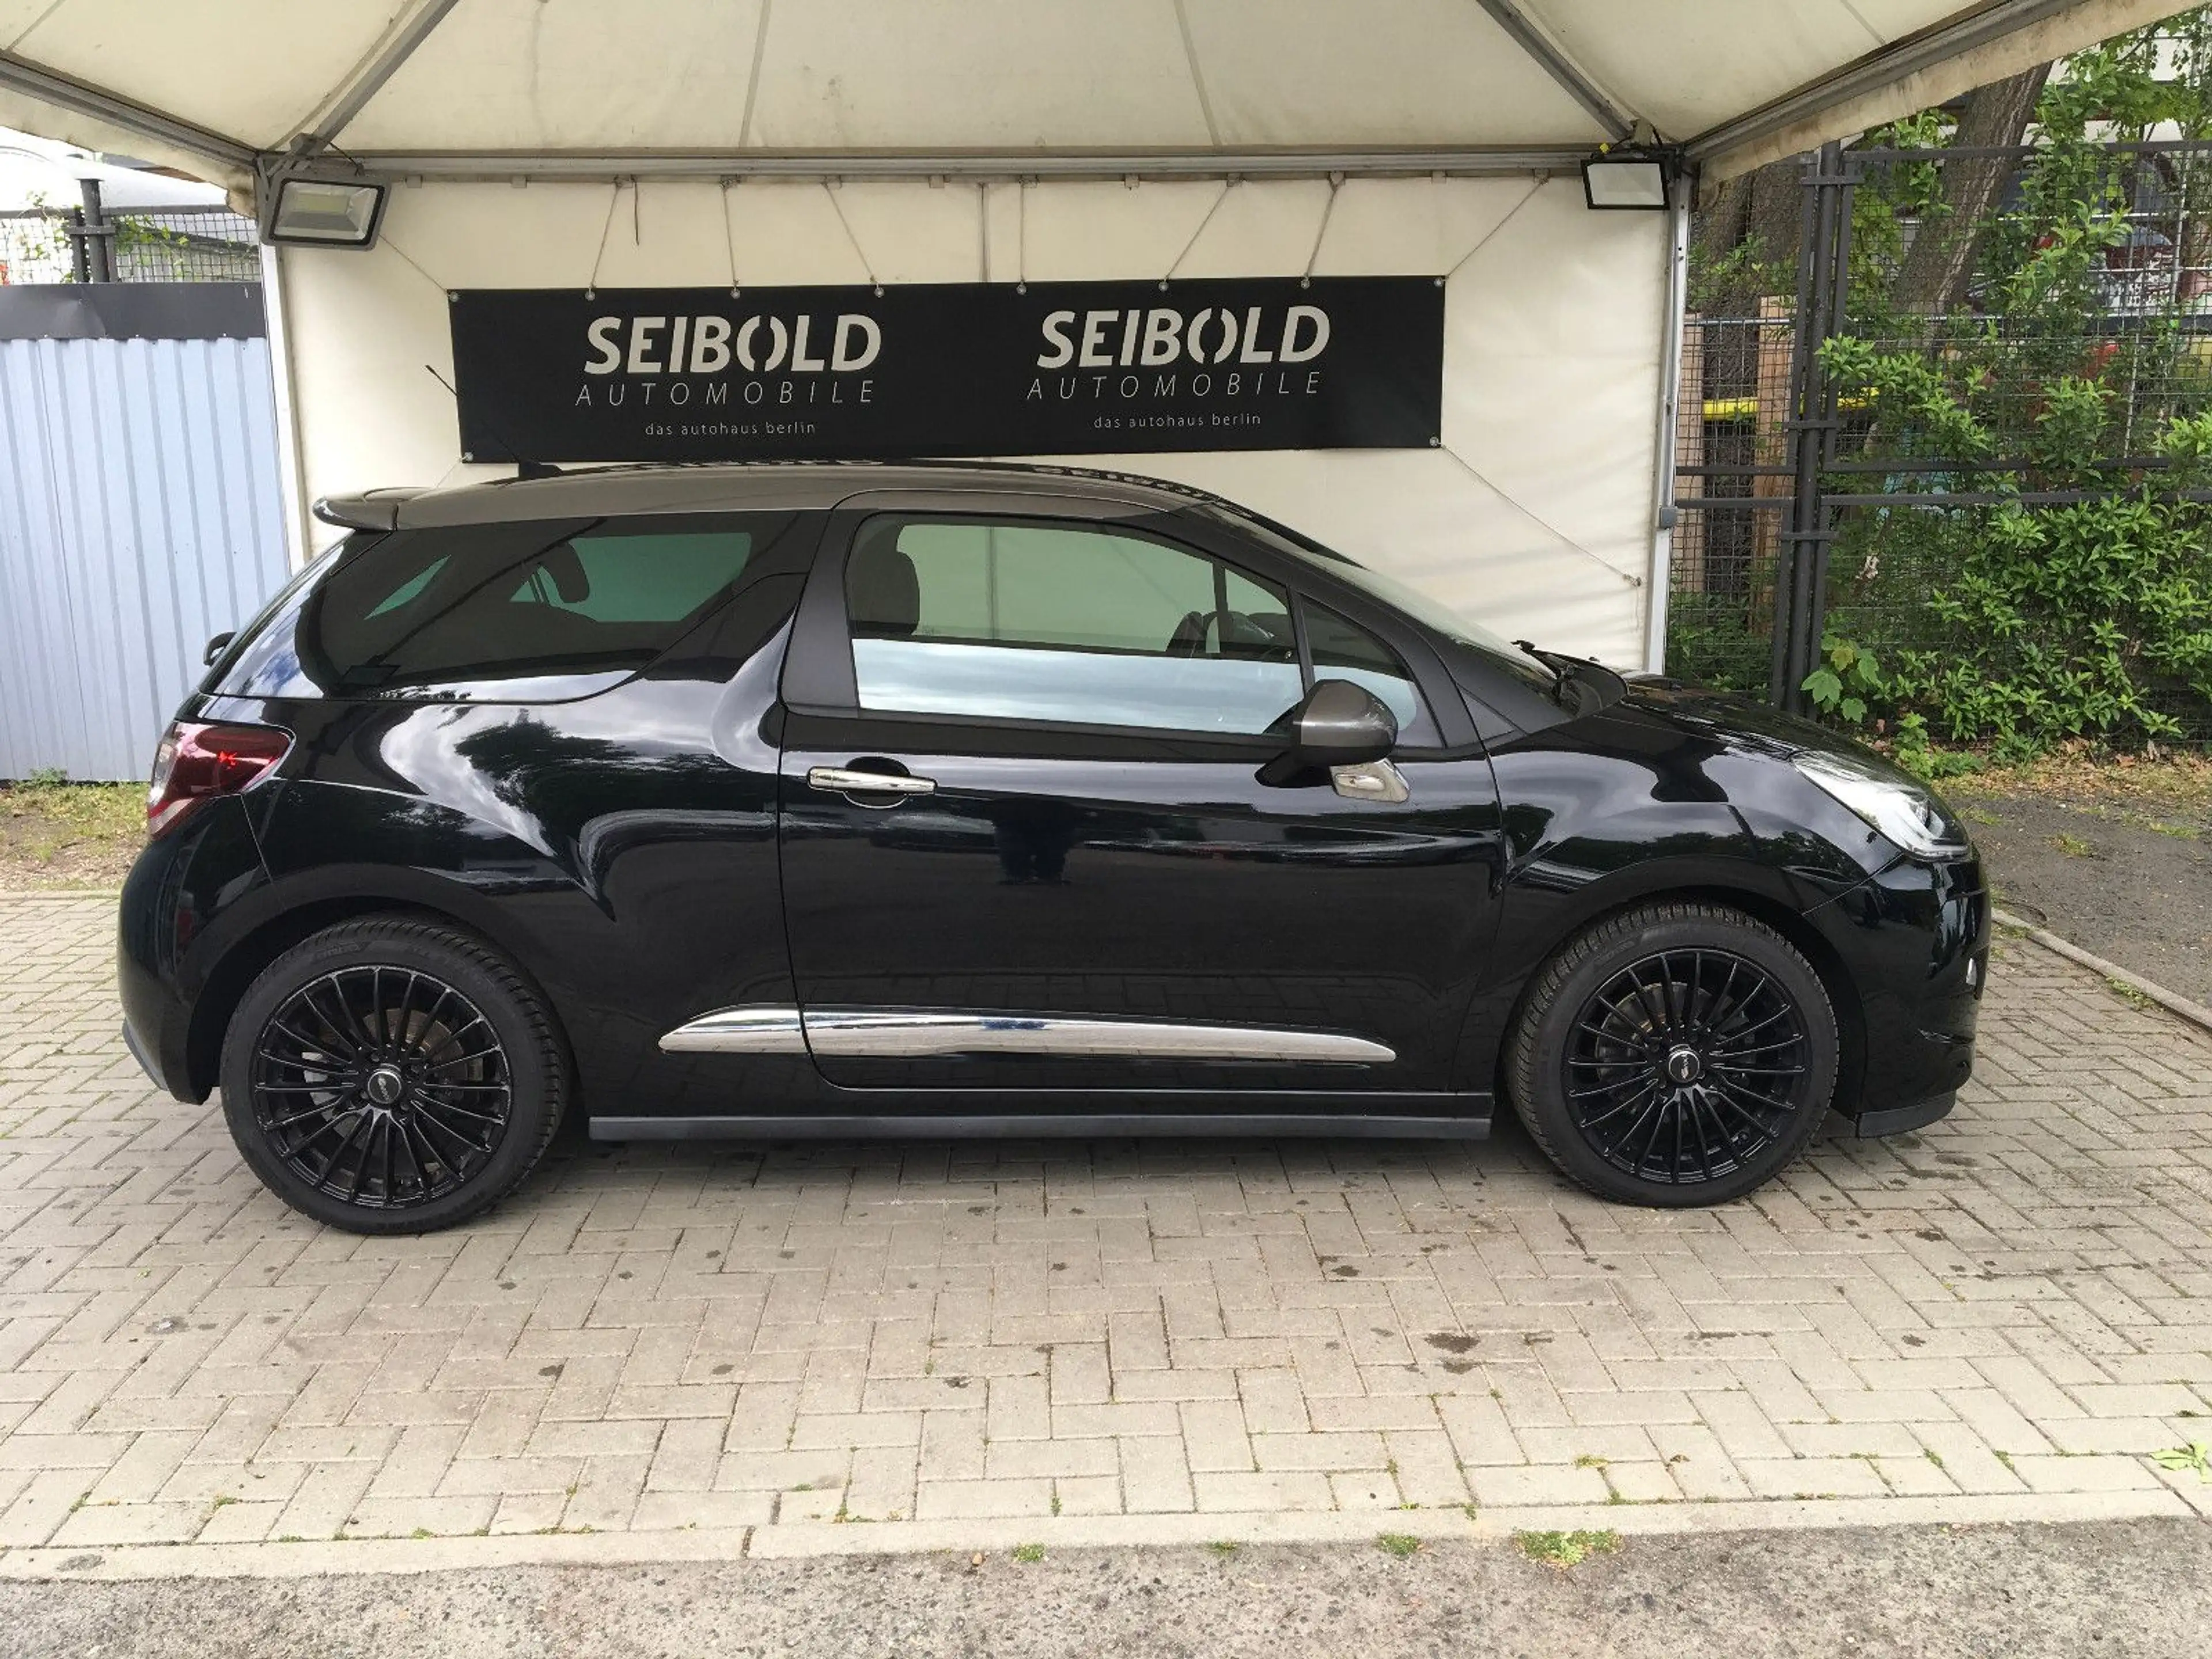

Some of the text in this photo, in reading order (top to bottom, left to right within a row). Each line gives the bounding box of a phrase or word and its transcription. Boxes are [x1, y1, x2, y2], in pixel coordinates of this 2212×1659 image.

[584, 313, 881, 375] SEIBOLD
[1036, 305, 1331, 369] SEIBOLD
[575, 380, 874, 406] AUTOMOBILE
[1027, 372, 1320, 400] AUTOMOBILE
[645, 421, 815, 435] das autohaus berlin
[1093, 412, 1260, 429] das autohaus berlin
